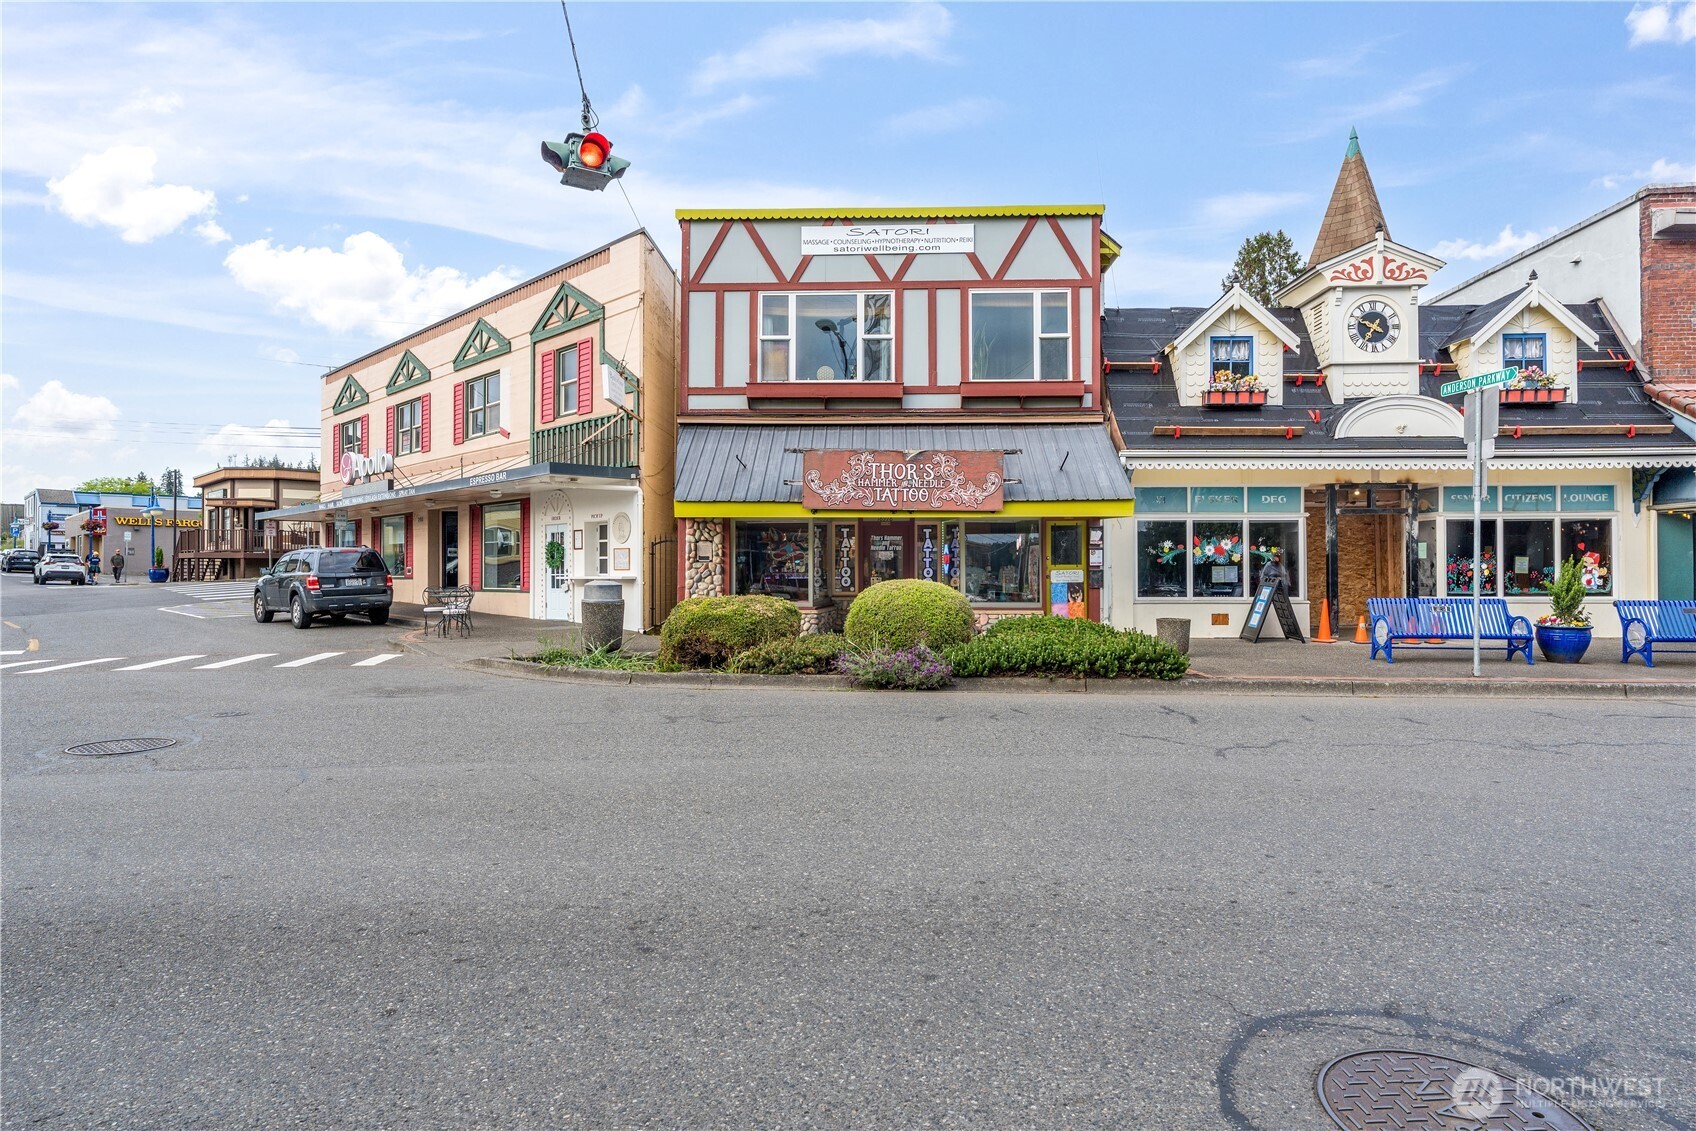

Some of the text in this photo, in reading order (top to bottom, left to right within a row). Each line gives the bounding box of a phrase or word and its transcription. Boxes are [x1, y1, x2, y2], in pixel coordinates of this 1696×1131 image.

[846, 228, 929, 236] SATORI
[874, 237, 921, 245] HYPNOTHERAPY
[924, 236, 956, 244] NUTRITION
[1442, 369, 1511, 395] ANDERSON PARKWAY
[353, 449, 392, 484] Apollo
[867, 463, 935, 480] THOR'S
[470, 471, 507, 486] ESPRESSO BAR
[858, 479, 898, 487] HAMMER
[913, 479, 946, 488] NEEDLE
[874, 488, 929, 507] TATTOO
[1505, 493, 1553, 503] CITIZENS
[841, 528, 851, 587] TATTOO
[951, 528, 960, 587] TATTOO
